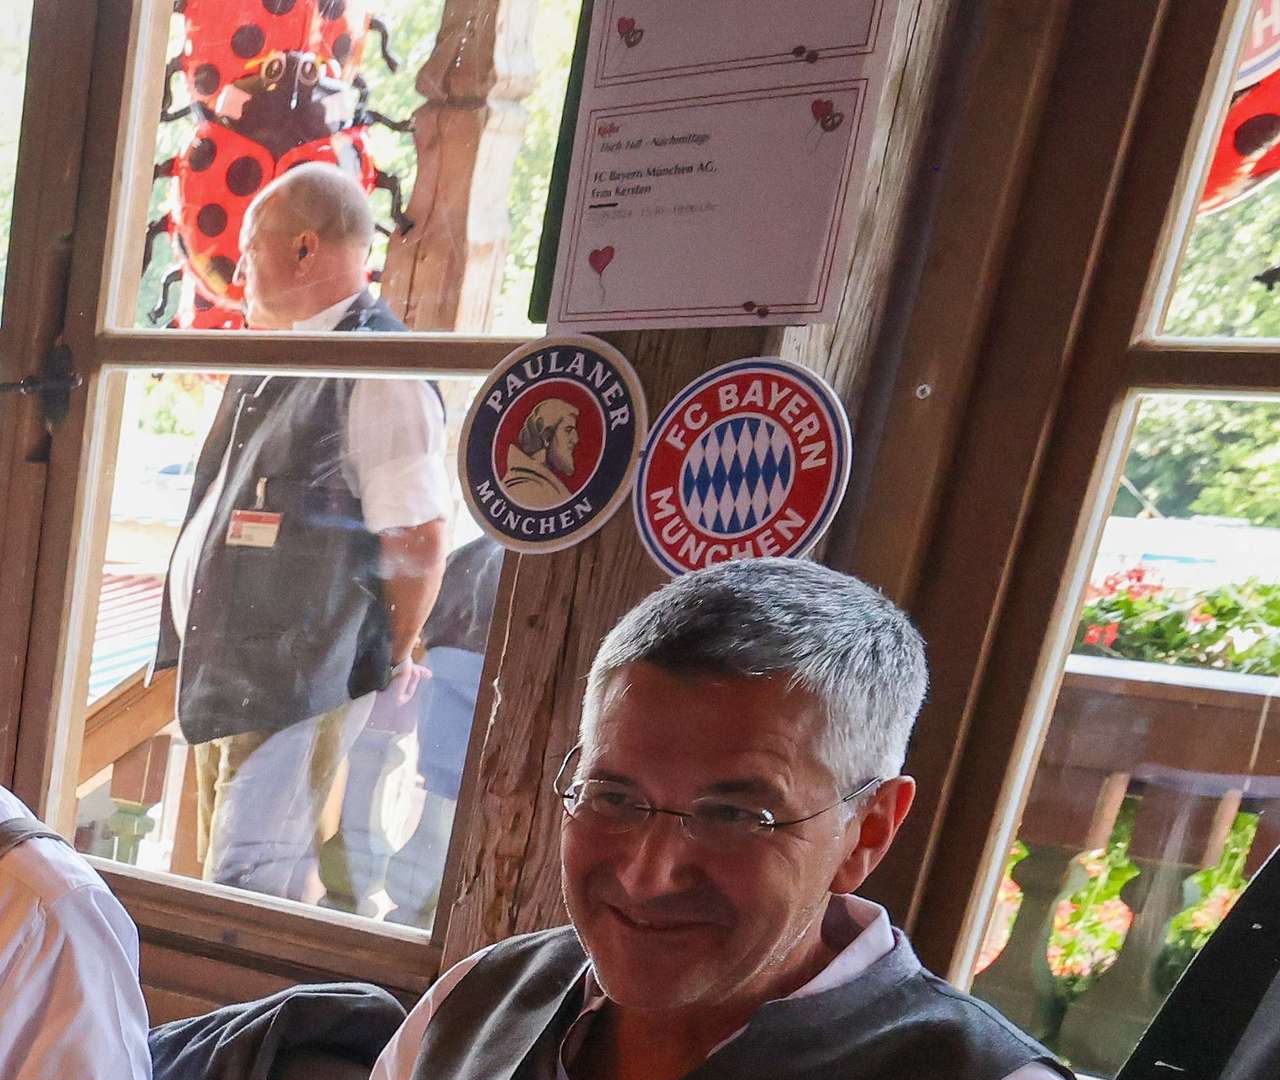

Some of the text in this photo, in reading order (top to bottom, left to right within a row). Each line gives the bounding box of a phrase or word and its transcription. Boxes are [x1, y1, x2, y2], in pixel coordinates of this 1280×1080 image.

[485, 351, 631, 431] PAULANER
[664, 380, 828, 471] FC BAYERN
[475, 478, 594, 536] MÜNCHEN
